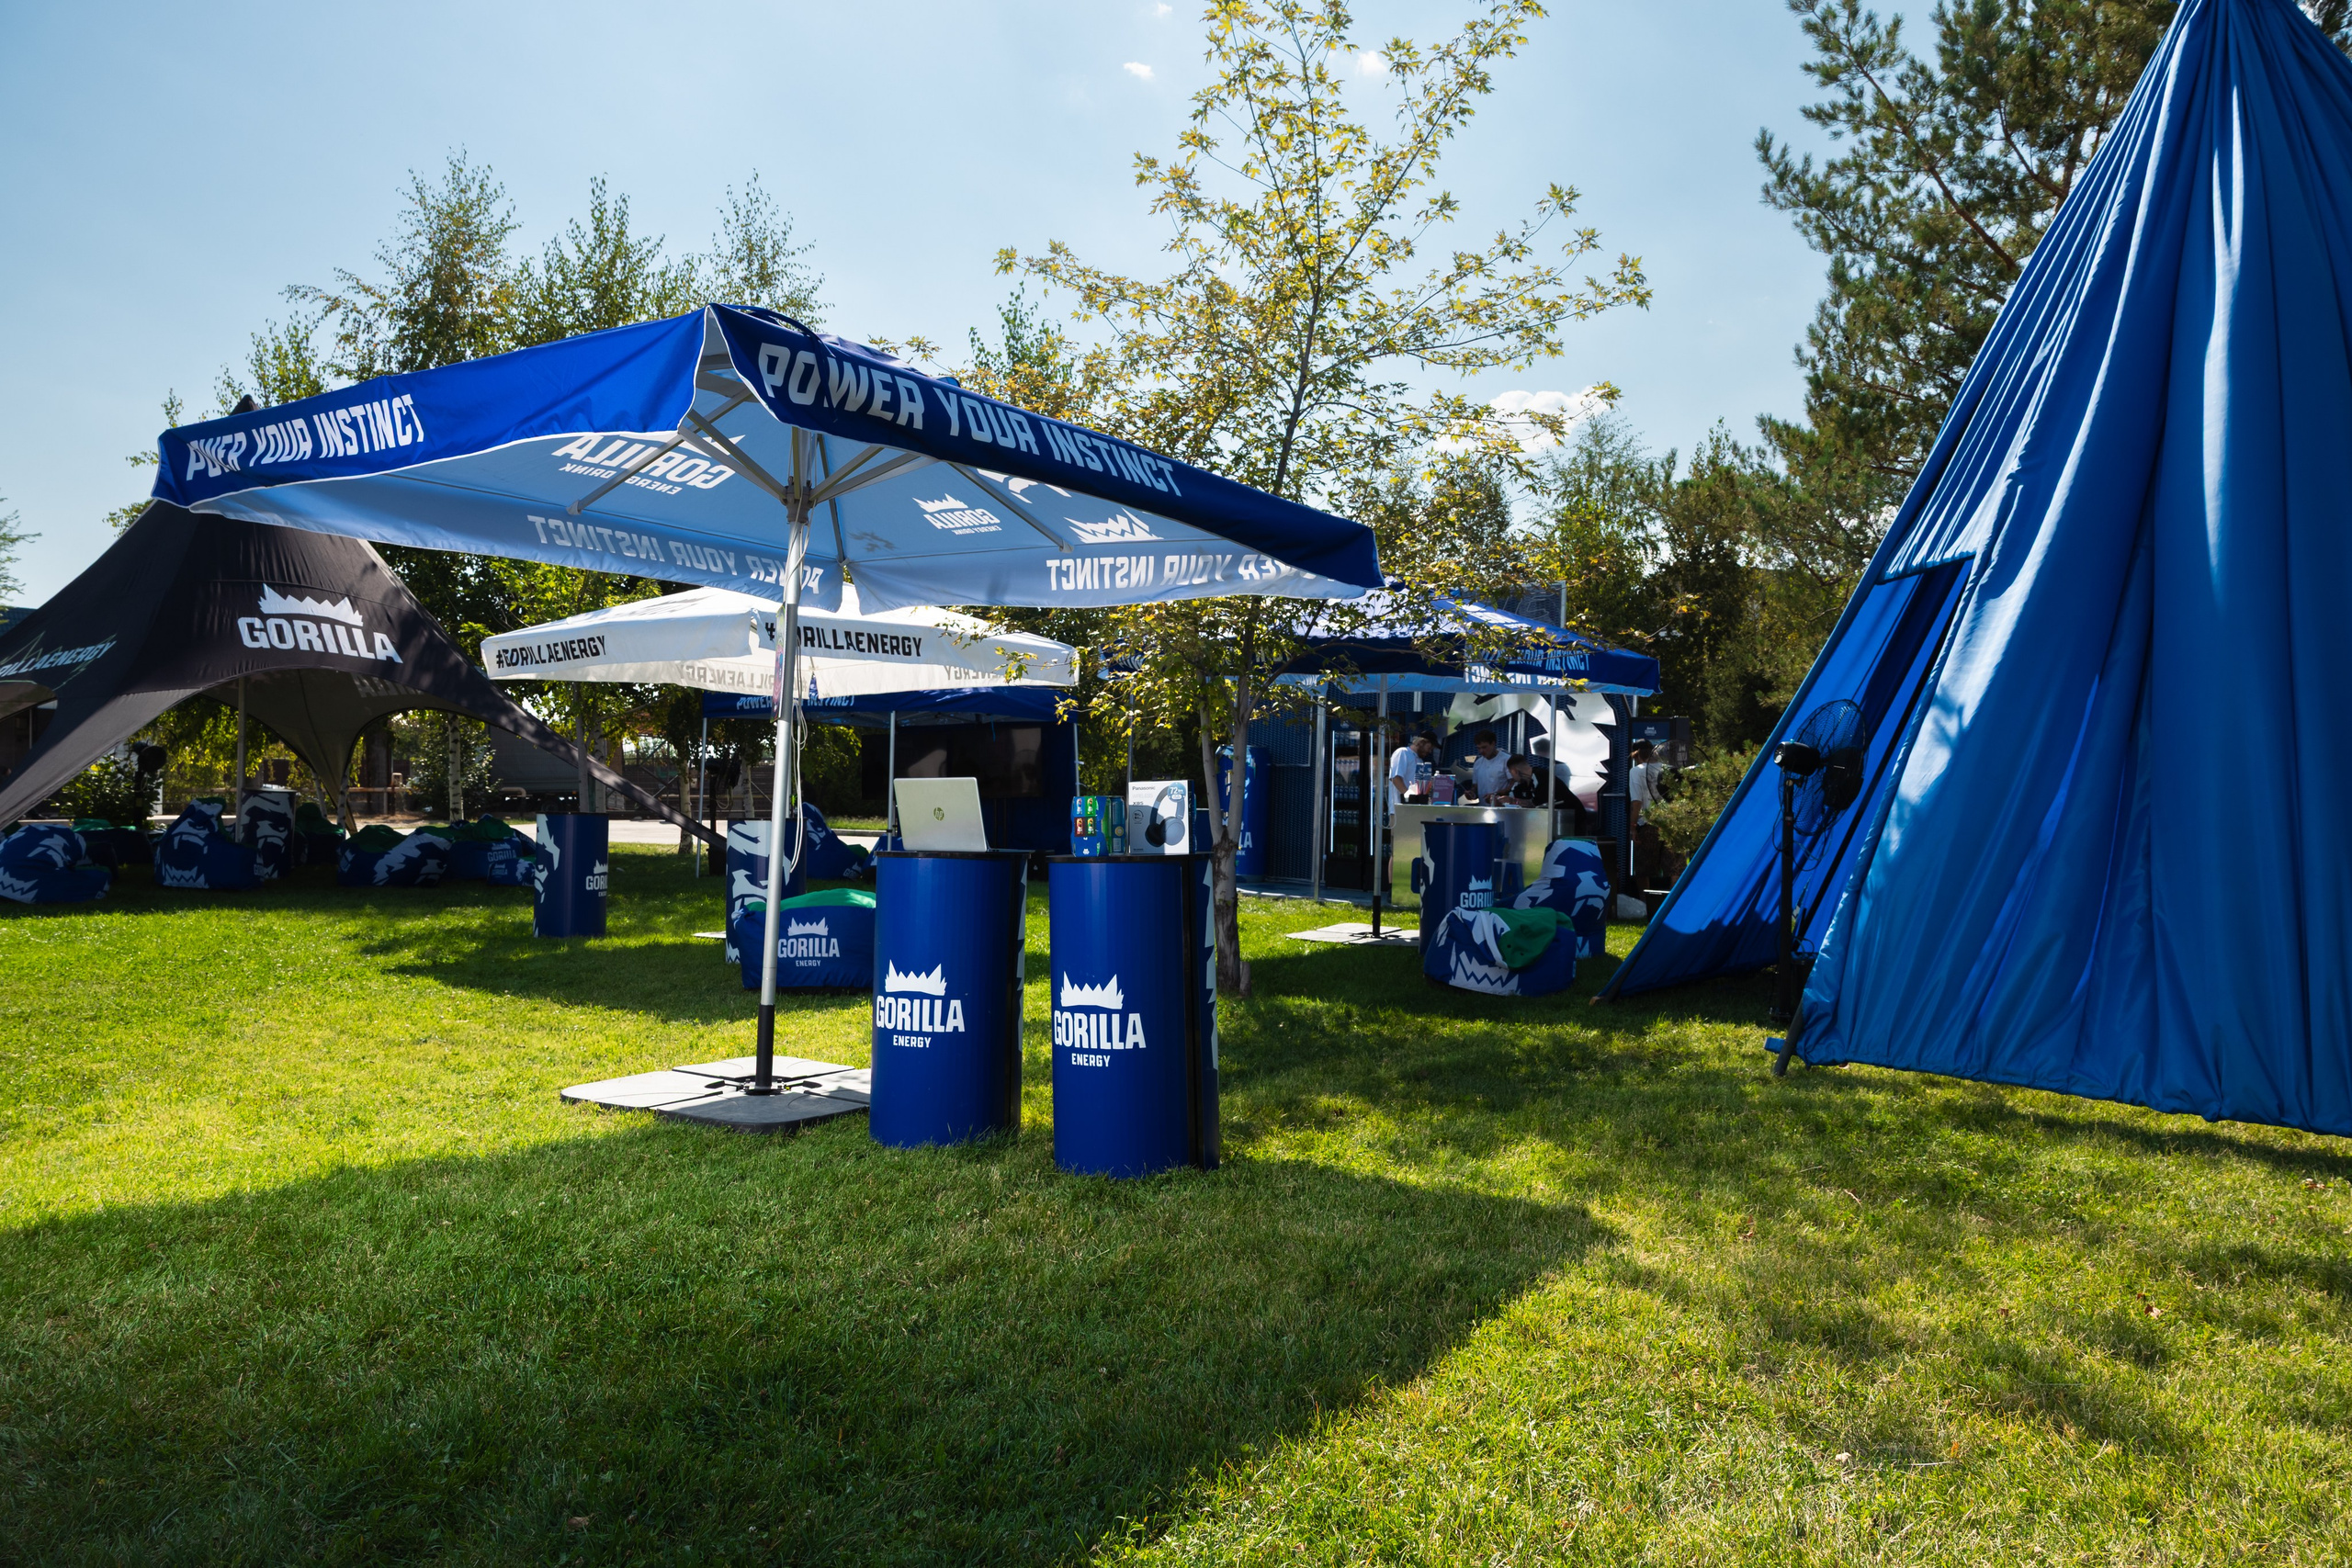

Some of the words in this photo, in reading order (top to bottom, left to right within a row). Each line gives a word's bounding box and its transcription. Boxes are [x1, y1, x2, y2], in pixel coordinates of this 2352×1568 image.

[249, 418, 313, 467] YOUR
[312, 393, 424, 458] INSTINCT
[758, 343, 925, 430] POWER
[933, 387, 1040, 456] YOUR
[1040, 421, 1182, 497] INSTINCT
[237, 616, 403, 664] GORILLA
[488, 850, 516, 862] GORILLA
[777, 937, 841, 958] GORILLA
[876, 995, 965, 1032] GORILLA
[1054, 1010, 1147, 1050] GORILLA
[893, 1034, 932, 1048] ENERGY
[1071, 1053, 1111, 1067] ENERGY
